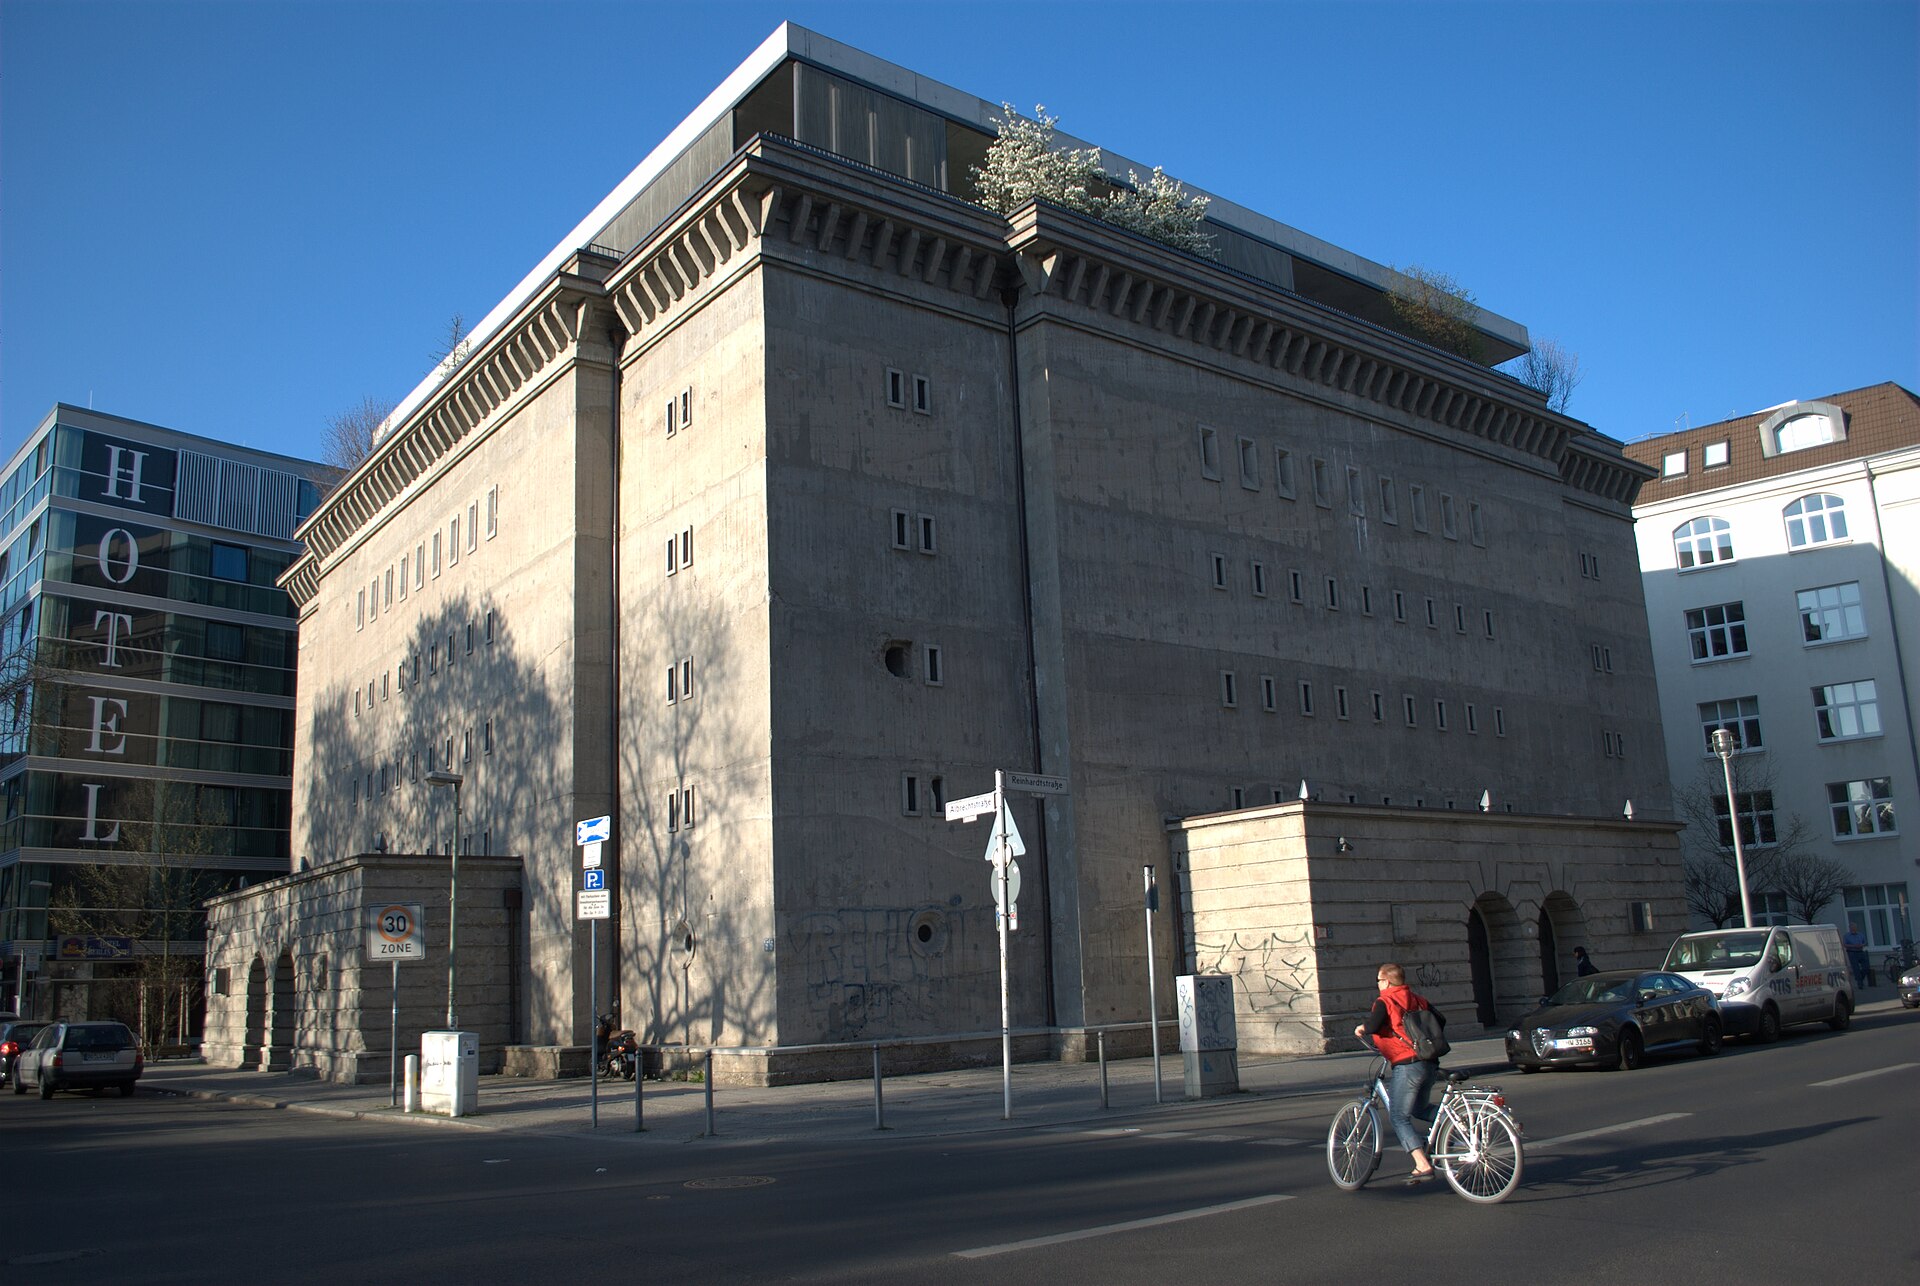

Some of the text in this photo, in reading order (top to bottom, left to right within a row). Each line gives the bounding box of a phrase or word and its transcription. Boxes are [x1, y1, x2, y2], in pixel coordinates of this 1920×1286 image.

[79, 444, 150, 843] HOTEL
[1011, 775, 1063, 790] Reinhardtstraße
[949, 798, 992, 813] Albrechtstraße
[587, 872, 599, 888] P
[385, 915, 407, 933] 30
[381, 943, 412, 954] ZONE
[1769, 977, 1792, 996] OTIS
[1795, 973, 1823, 989] SERVICE
[1827, 971, 1846, 988] OTIS
